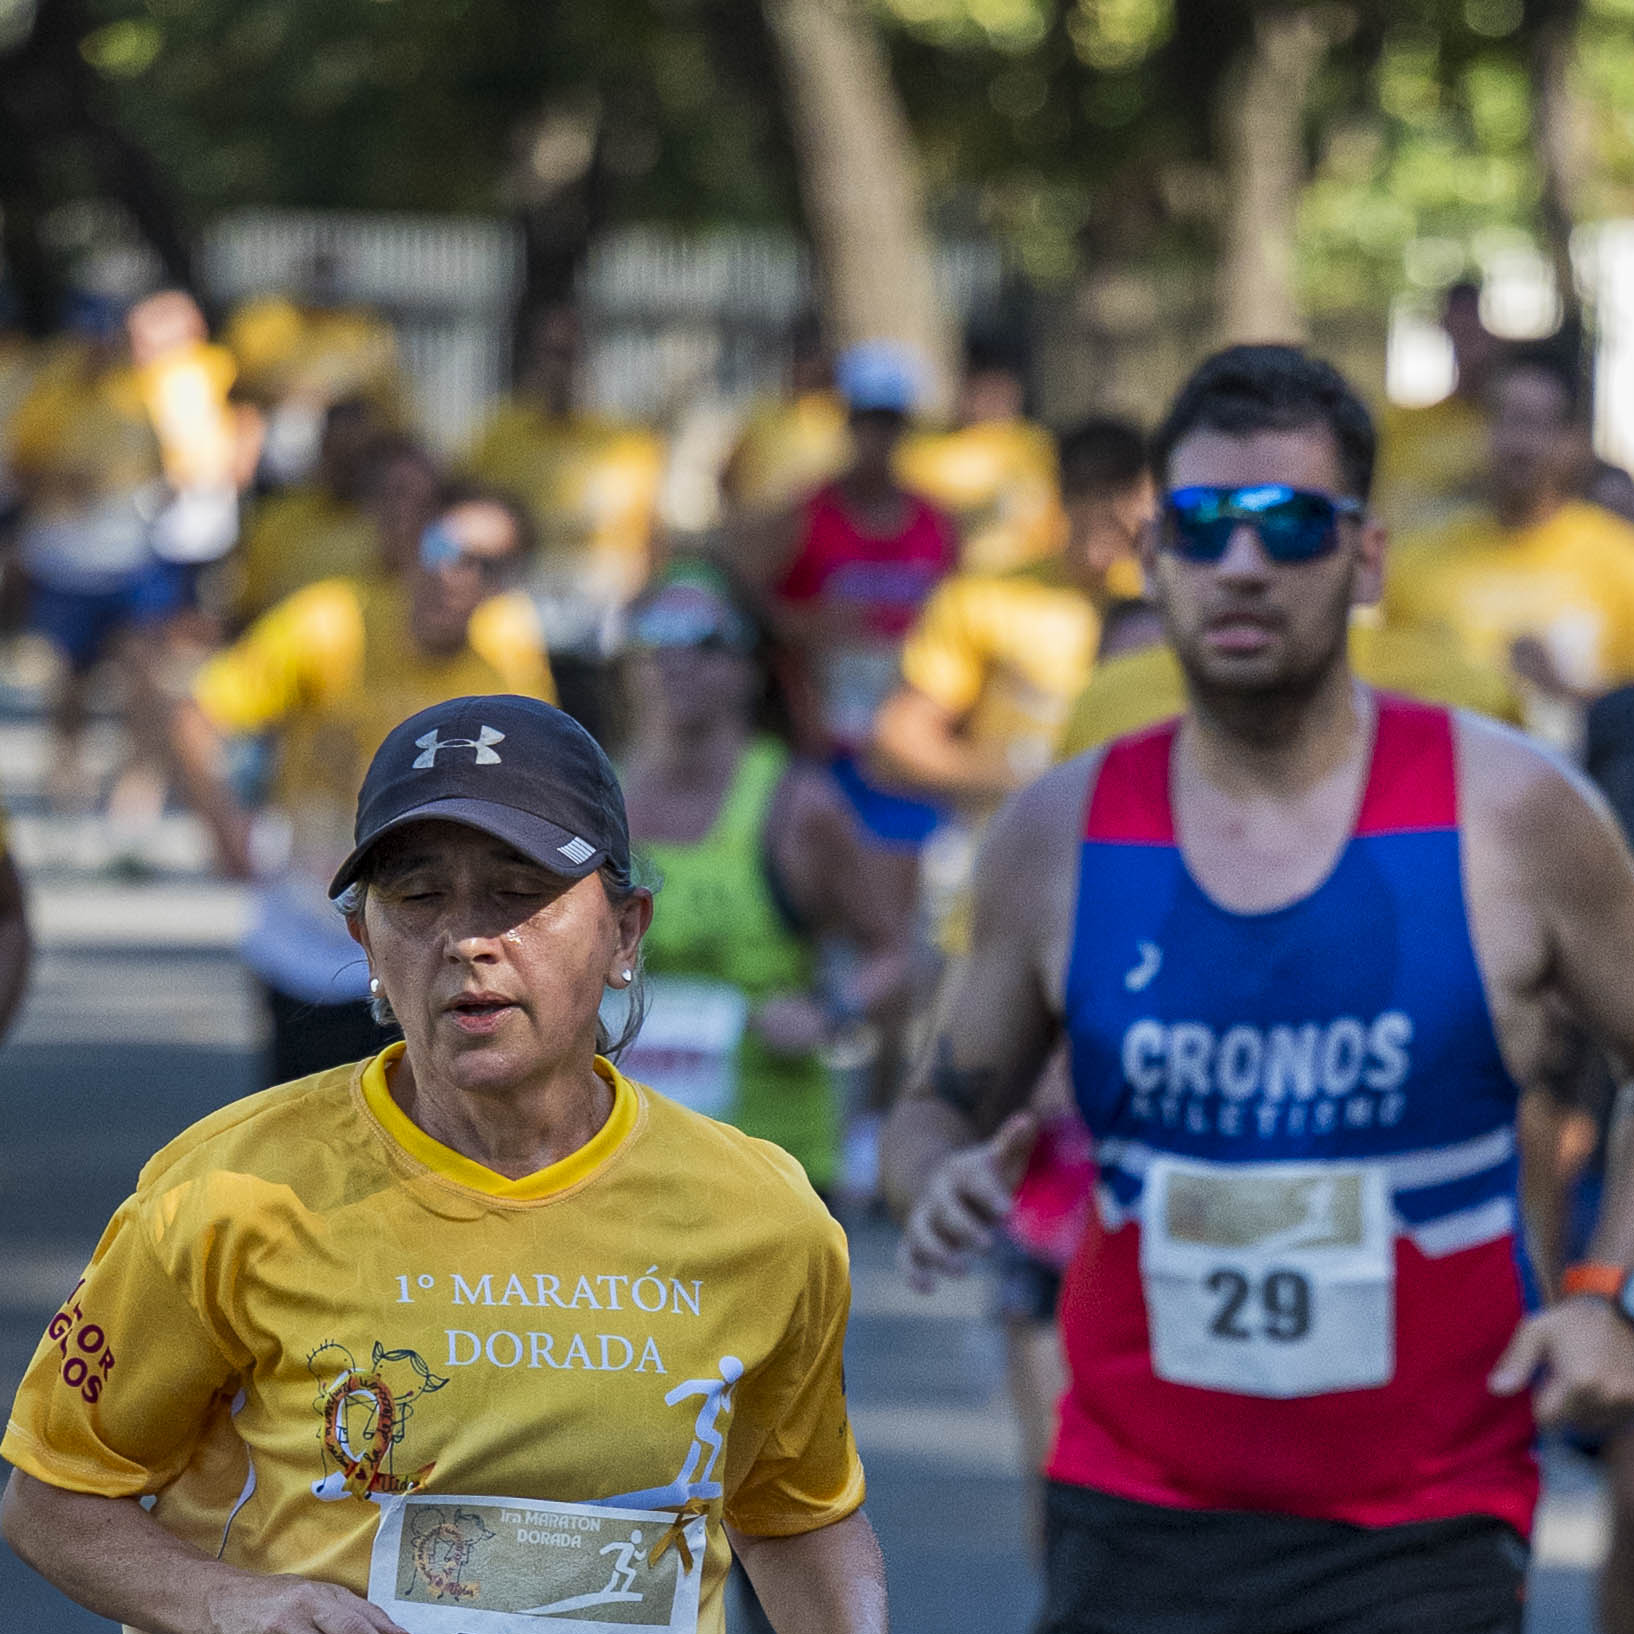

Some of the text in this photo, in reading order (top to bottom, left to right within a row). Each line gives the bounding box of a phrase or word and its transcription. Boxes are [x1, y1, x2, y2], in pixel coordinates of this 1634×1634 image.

[1123, 1011, 1413, 1101] CRONOS
[450, 1264, 703, 1316] MARATÓN
[1206, 1267, 1311, 1341] 29
[445, 1329, 668, 1374] DORADA
[517, 1528, 582, 1548] DORADA
